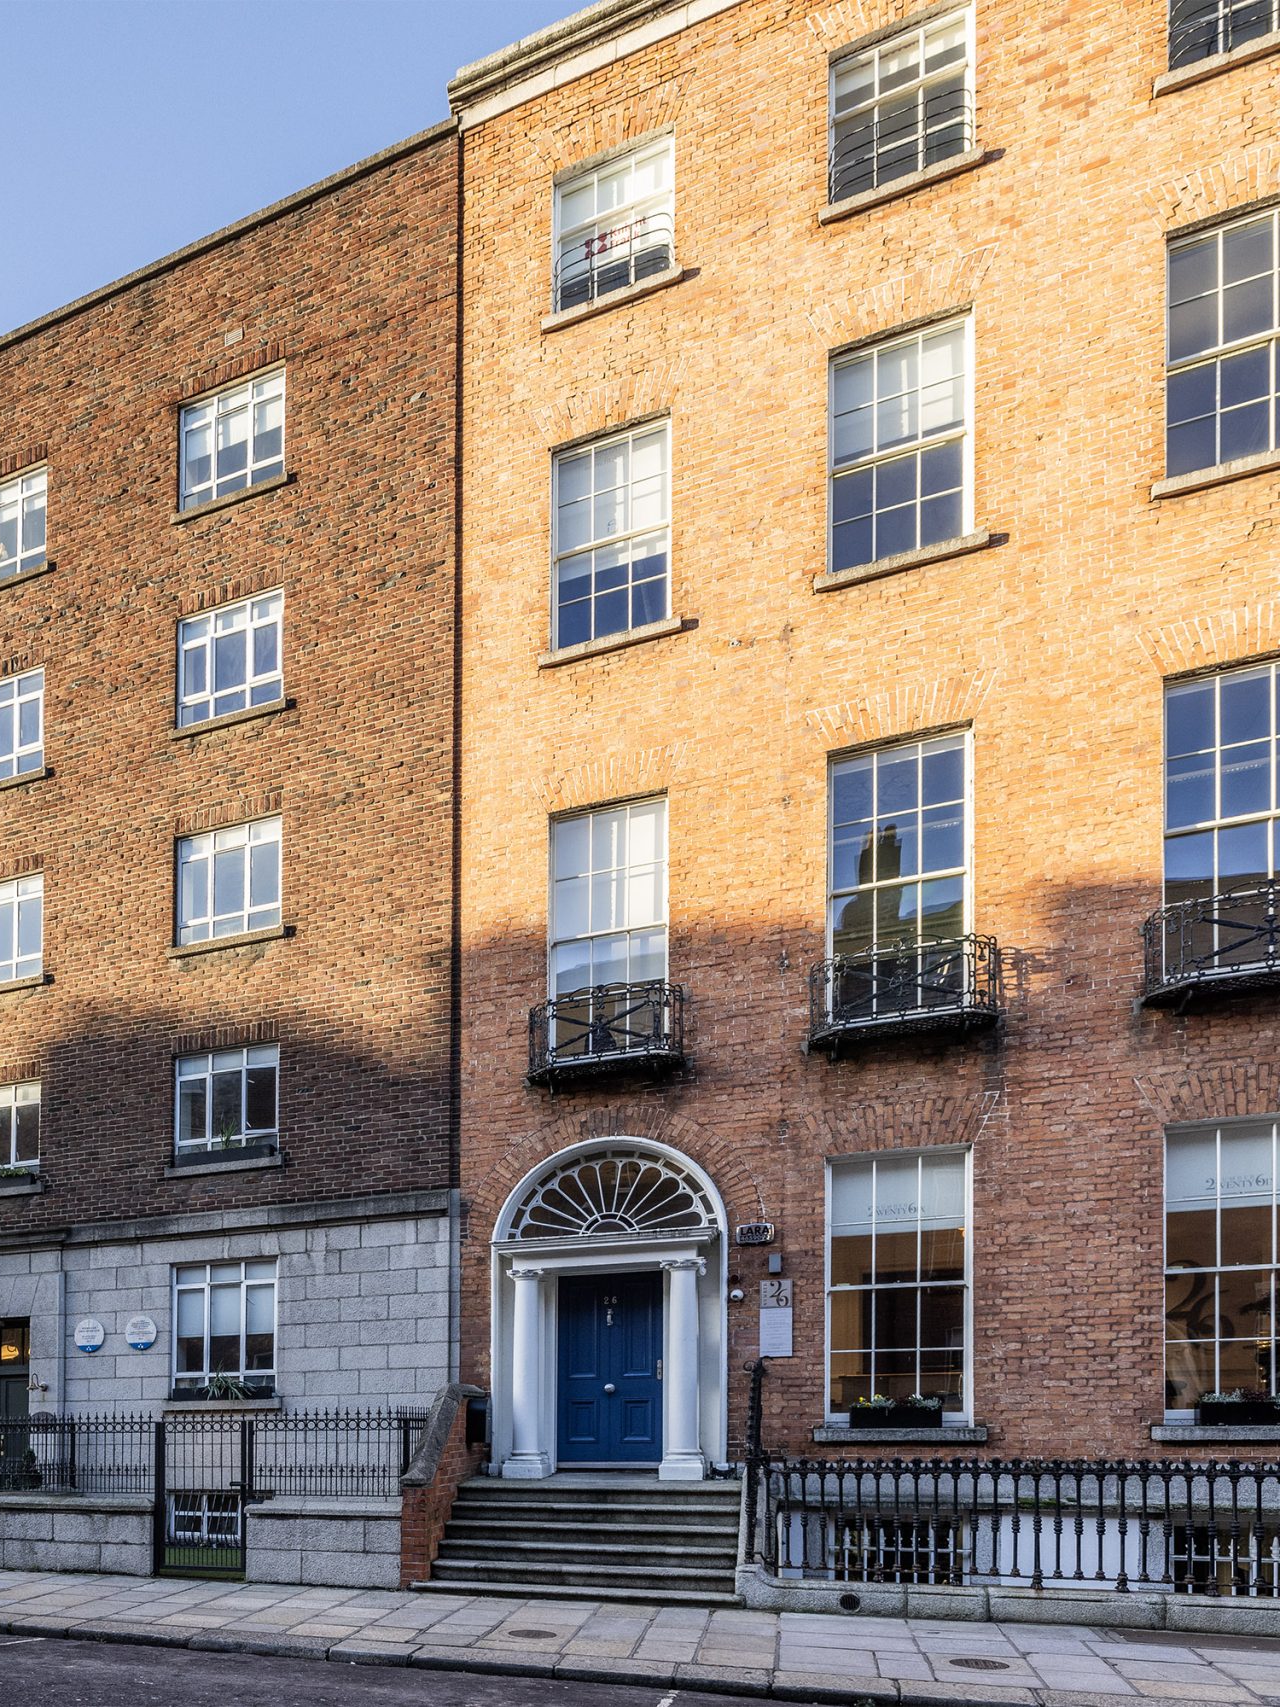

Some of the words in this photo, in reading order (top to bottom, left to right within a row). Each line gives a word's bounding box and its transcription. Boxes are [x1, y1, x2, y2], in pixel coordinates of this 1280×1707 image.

[740, 1226, 770, 1235] LARA
[770, 1280, 789, 1306] 26
[604, 1296, 617, 1304] 26
